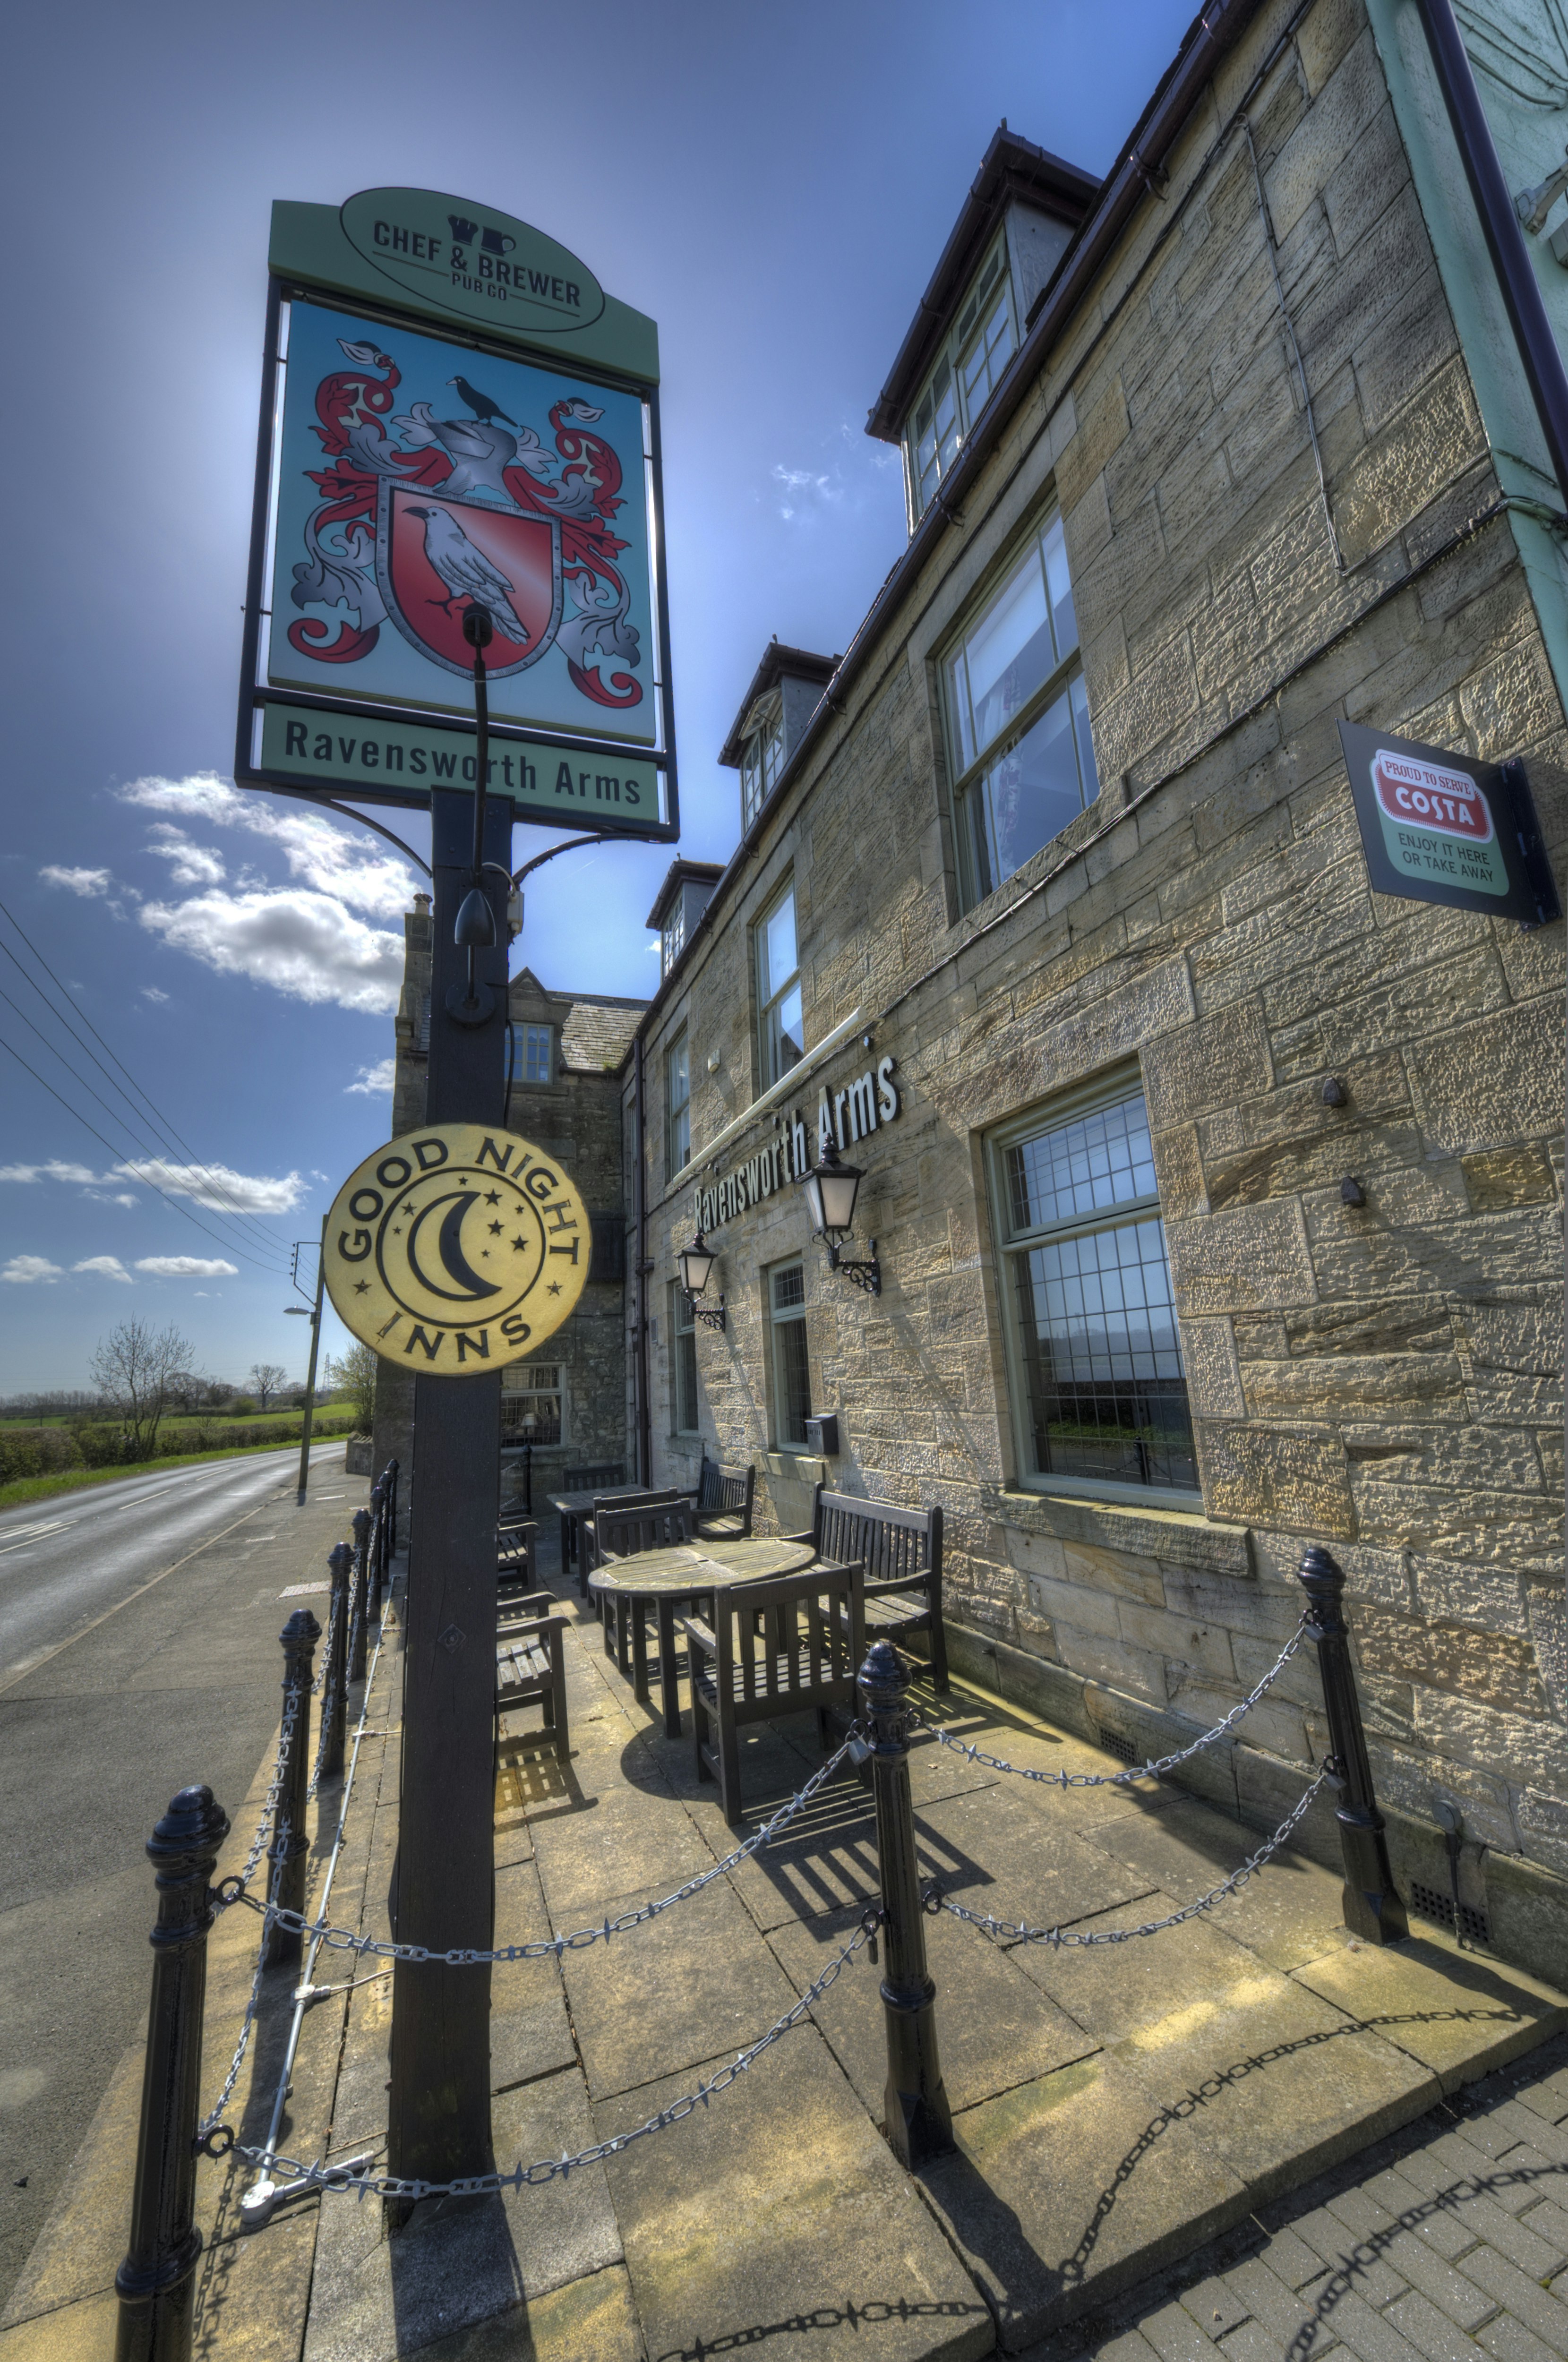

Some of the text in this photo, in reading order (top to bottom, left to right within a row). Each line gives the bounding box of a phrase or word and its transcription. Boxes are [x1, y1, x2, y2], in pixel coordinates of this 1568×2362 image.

[373, 220, 581, 307] CHEF & BREWER
[452, 271, 483, 293] PUB
[285, 720, 641, 805] Ravensworth Arms
[1385, 761, 1471, 795] PROUD TO SERVE
[1395, 787, 1475, 826] COSTA
[1398, 832, 1490, 865] ENJOY IT HERE
[1403, 851, 1493, 882] OR TAKE AWAY
[694, 1056, 900, 1234] Ravensworth Arms
[338, 1136, 580, 1265] GOOD NIGHT
[377, 1310, 531, 1361] INNS
